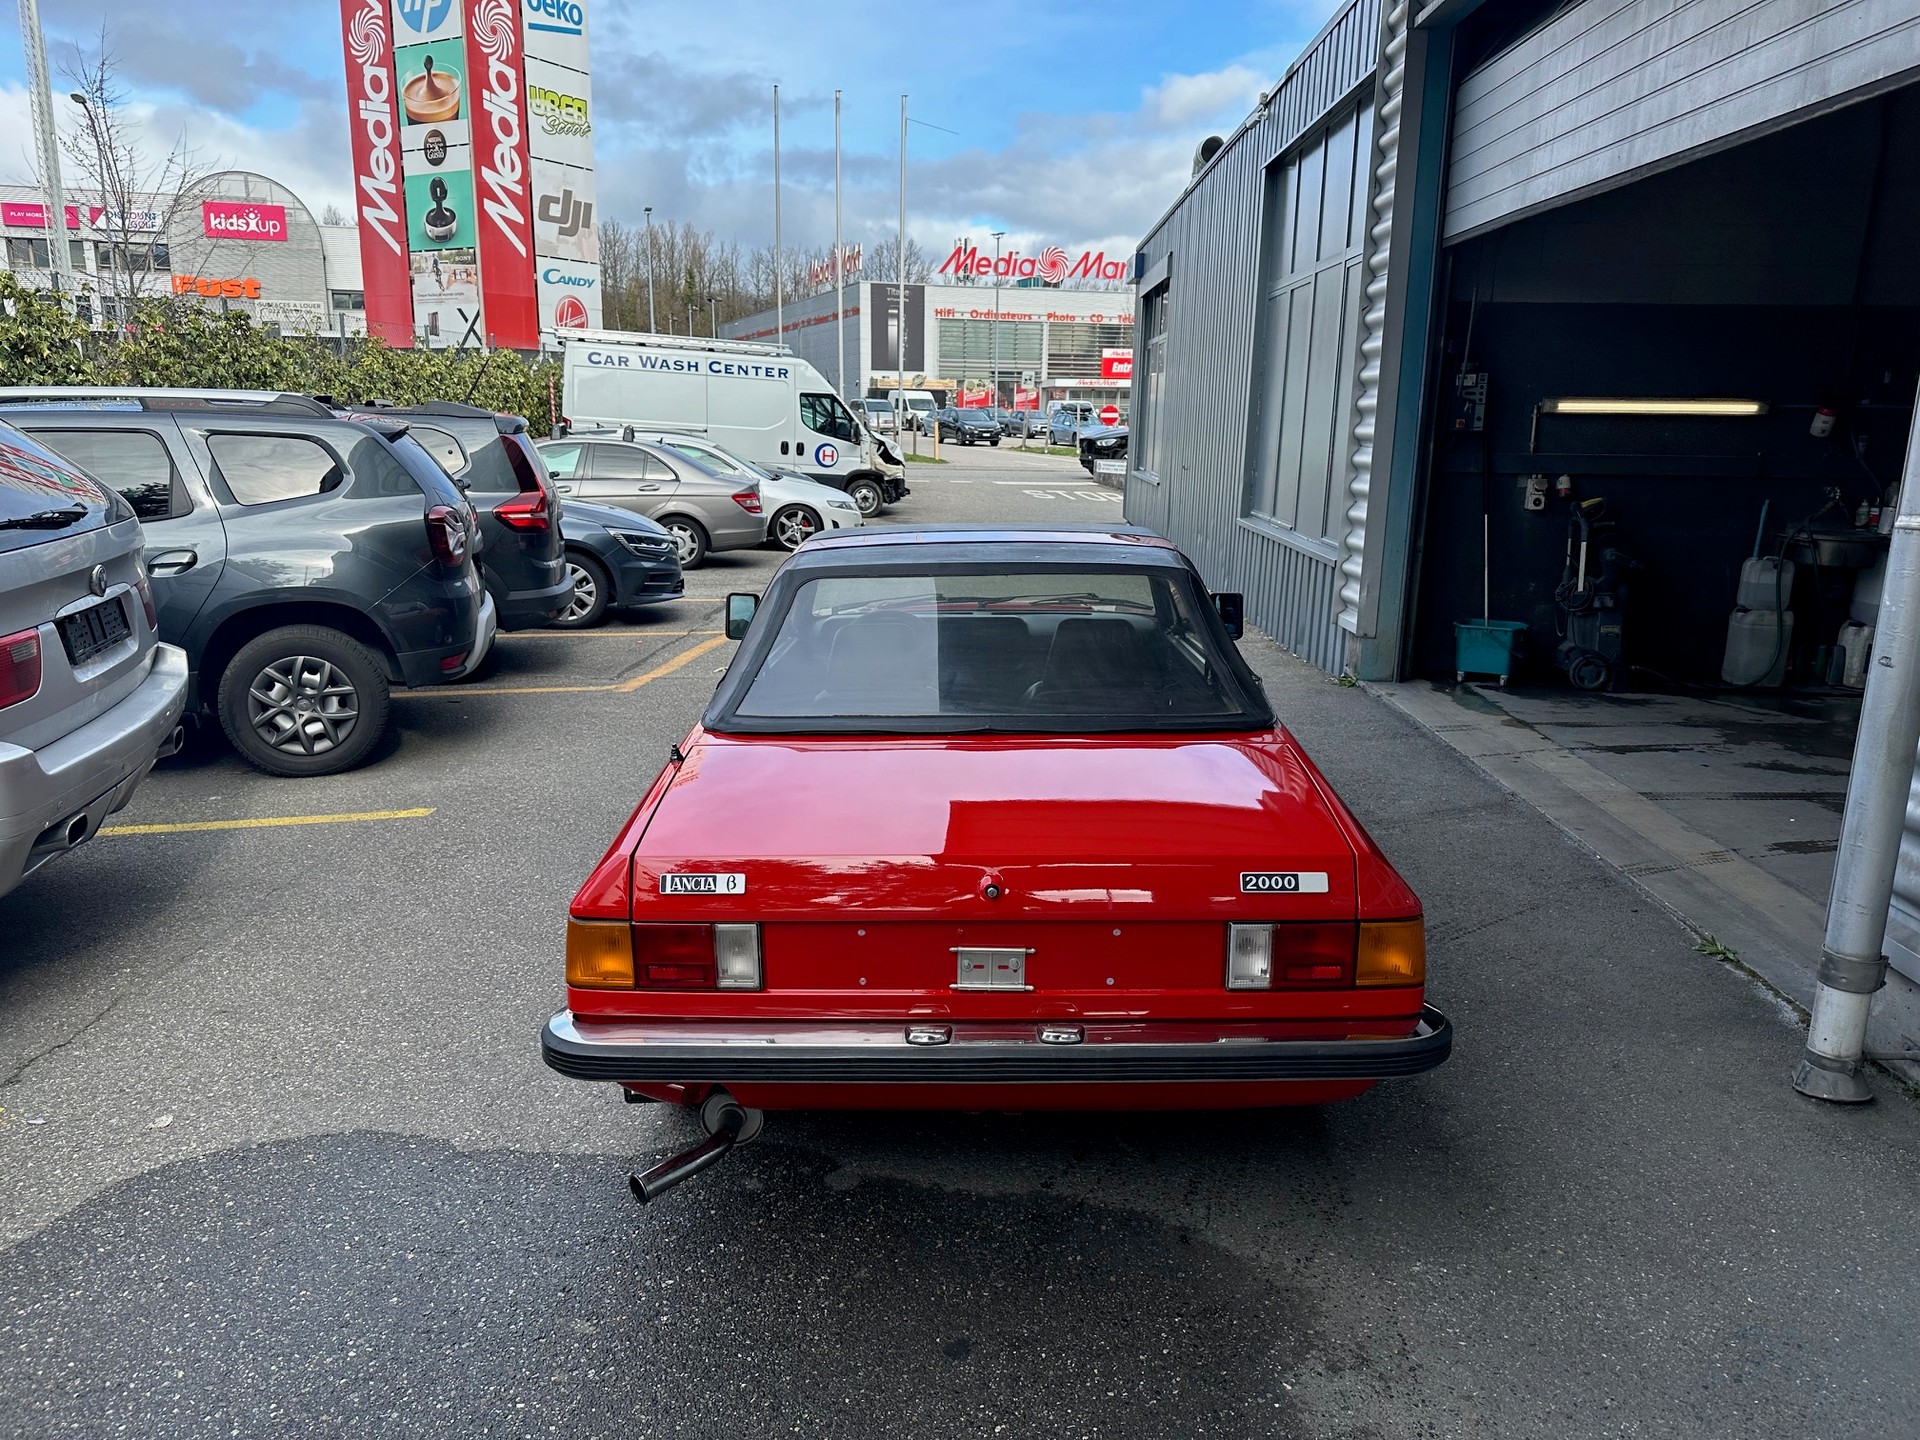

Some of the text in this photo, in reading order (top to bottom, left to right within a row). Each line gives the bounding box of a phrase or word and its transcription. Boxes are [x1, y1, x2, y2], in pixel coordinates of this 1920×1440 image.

[359, 64, 401, 257] Media
[482, 57, 527, 259] Media
[107, 211, 157, 221] DISOUNT
[210, 213, 281, 237] kids up
[938, 246, 1037, 277] Media
[935, 308, 955, 317] HiFi
[1047, 312, 1076, 322] Photo
[1089, 313, 1104, 323] CD
[587, 351, 790, 380] CAR WASH CENTER
[1021, 489, 1125, 503] STOP
[1245, 875, 1296, 890] 2000
